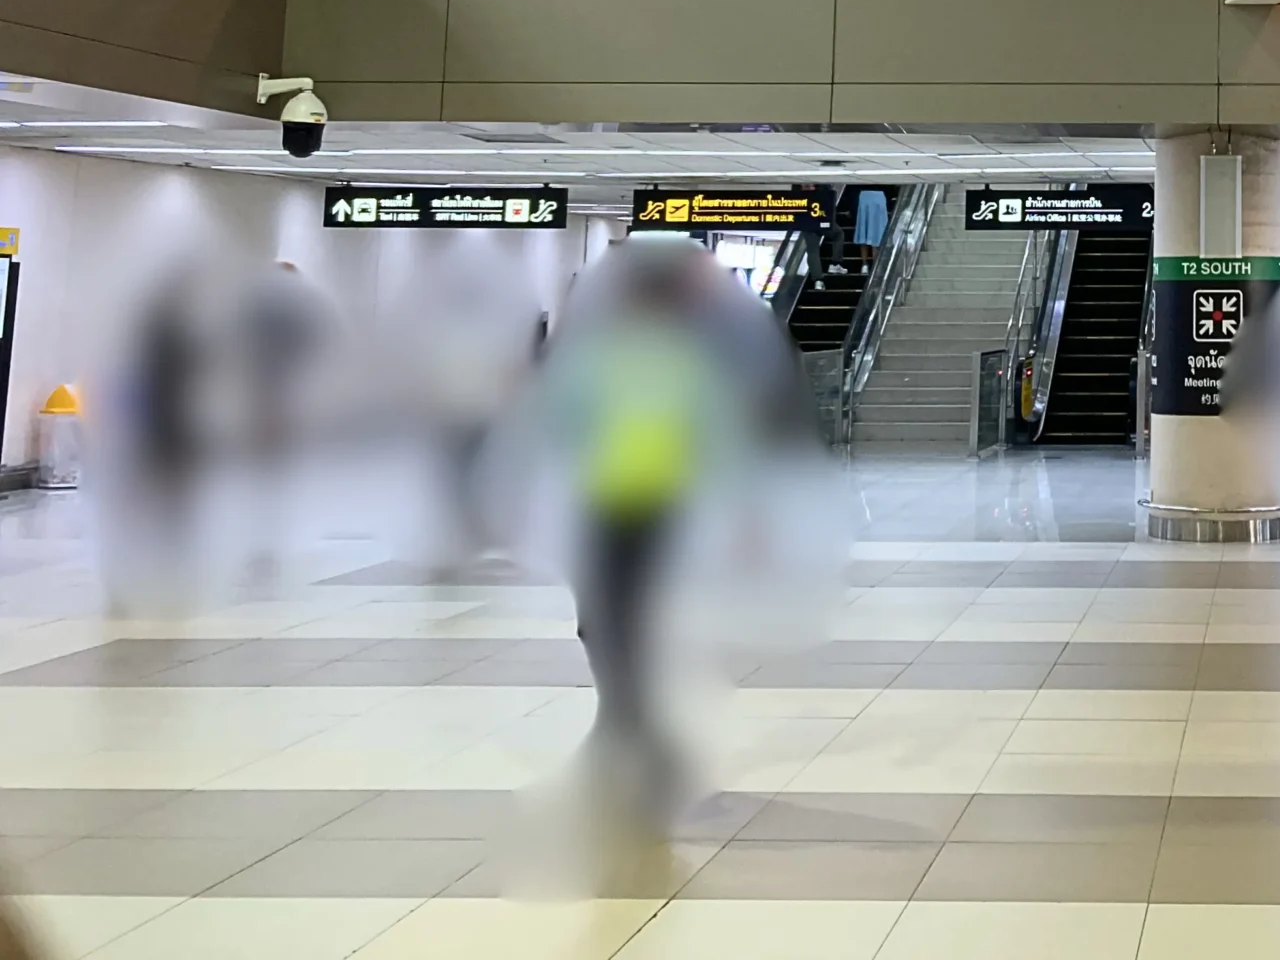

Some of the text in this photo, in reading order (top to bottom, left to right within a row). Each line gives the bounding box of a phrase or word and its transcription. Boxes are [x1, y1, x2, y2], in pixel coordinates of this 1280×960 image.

[691, 214, 722, 222] Domestic
[723, 214, 760, 223] Departures
[1182, 262, 1252, 275] T2 SOUTH
